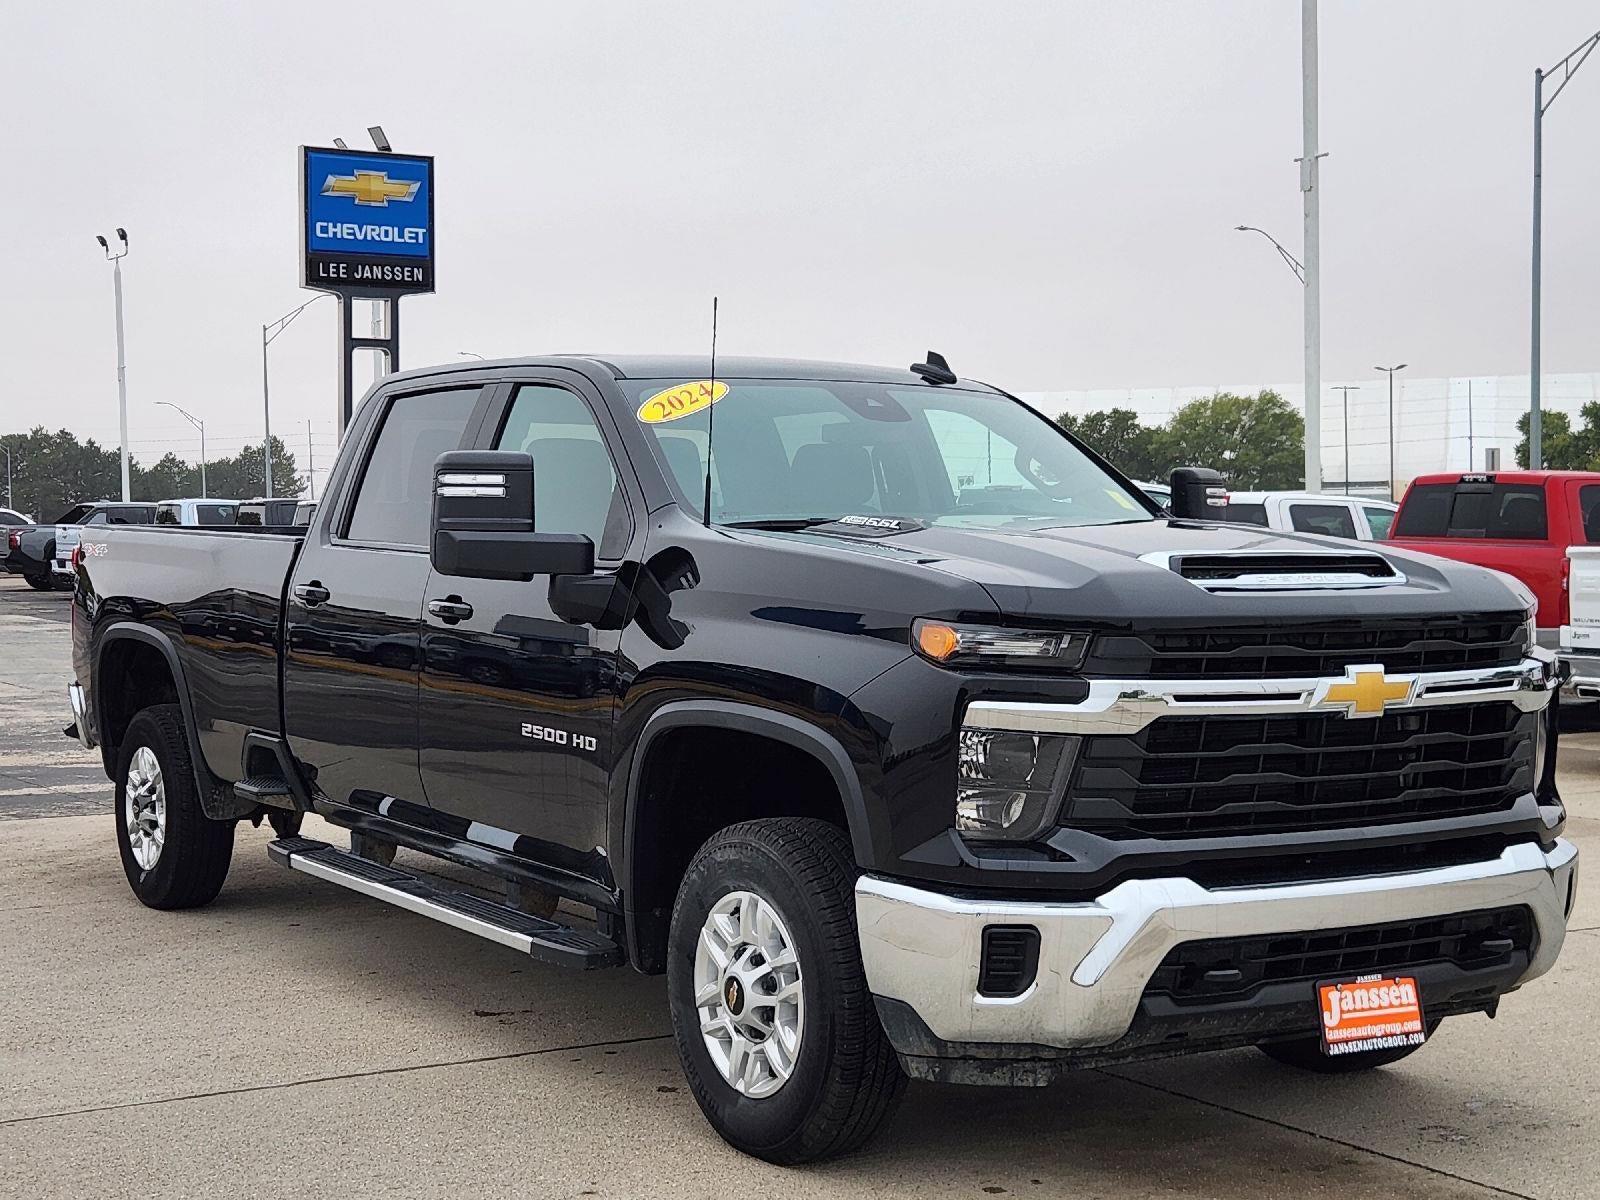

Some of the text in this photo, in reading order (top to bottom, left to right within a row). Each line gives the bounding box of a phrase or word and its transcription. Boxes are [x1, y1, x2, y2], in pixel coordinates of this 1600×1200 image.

[315, 221, 427, 244] CHEVROLET
[319, 262, 423, 282] LEE JANSSEN
[652, 383, 713, 418] 2024
[521, 722, 597, 751] 2500 HD
[1323, 983, 1416, 1027] Janssen
